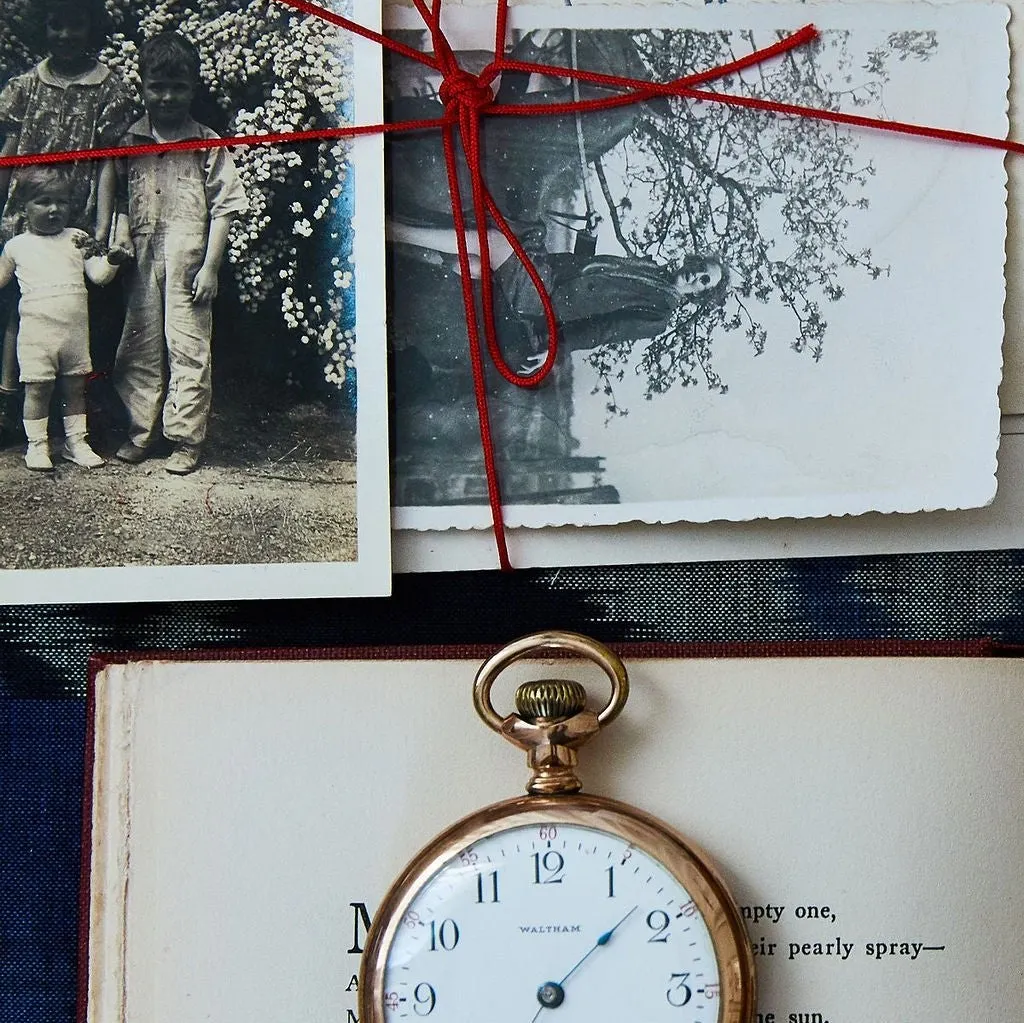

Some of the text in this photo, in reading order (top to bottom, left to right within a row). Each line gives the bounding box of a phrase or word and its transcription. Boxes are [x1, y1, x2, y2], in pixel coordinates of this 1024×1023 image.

[539, 826, 558, 841] 60
[529, 850, 566, 885] 12
[604, 865, 617, 899] 1
[474, 870, 502, 905] 11
[518, 925, 581, 934] WALTHAM
[646, 909, 672, 945] 2
[740, 903, 837, 924] mpty one,
[428, 918, 460, 952] 10
[751, 937, 777, 956] eir
[788, 937, 854, 960] pearly
[413, 982, 437, 1017] 9
[666, 972, 693, 1008] 3
[704, 983, 720, 1000] 15
